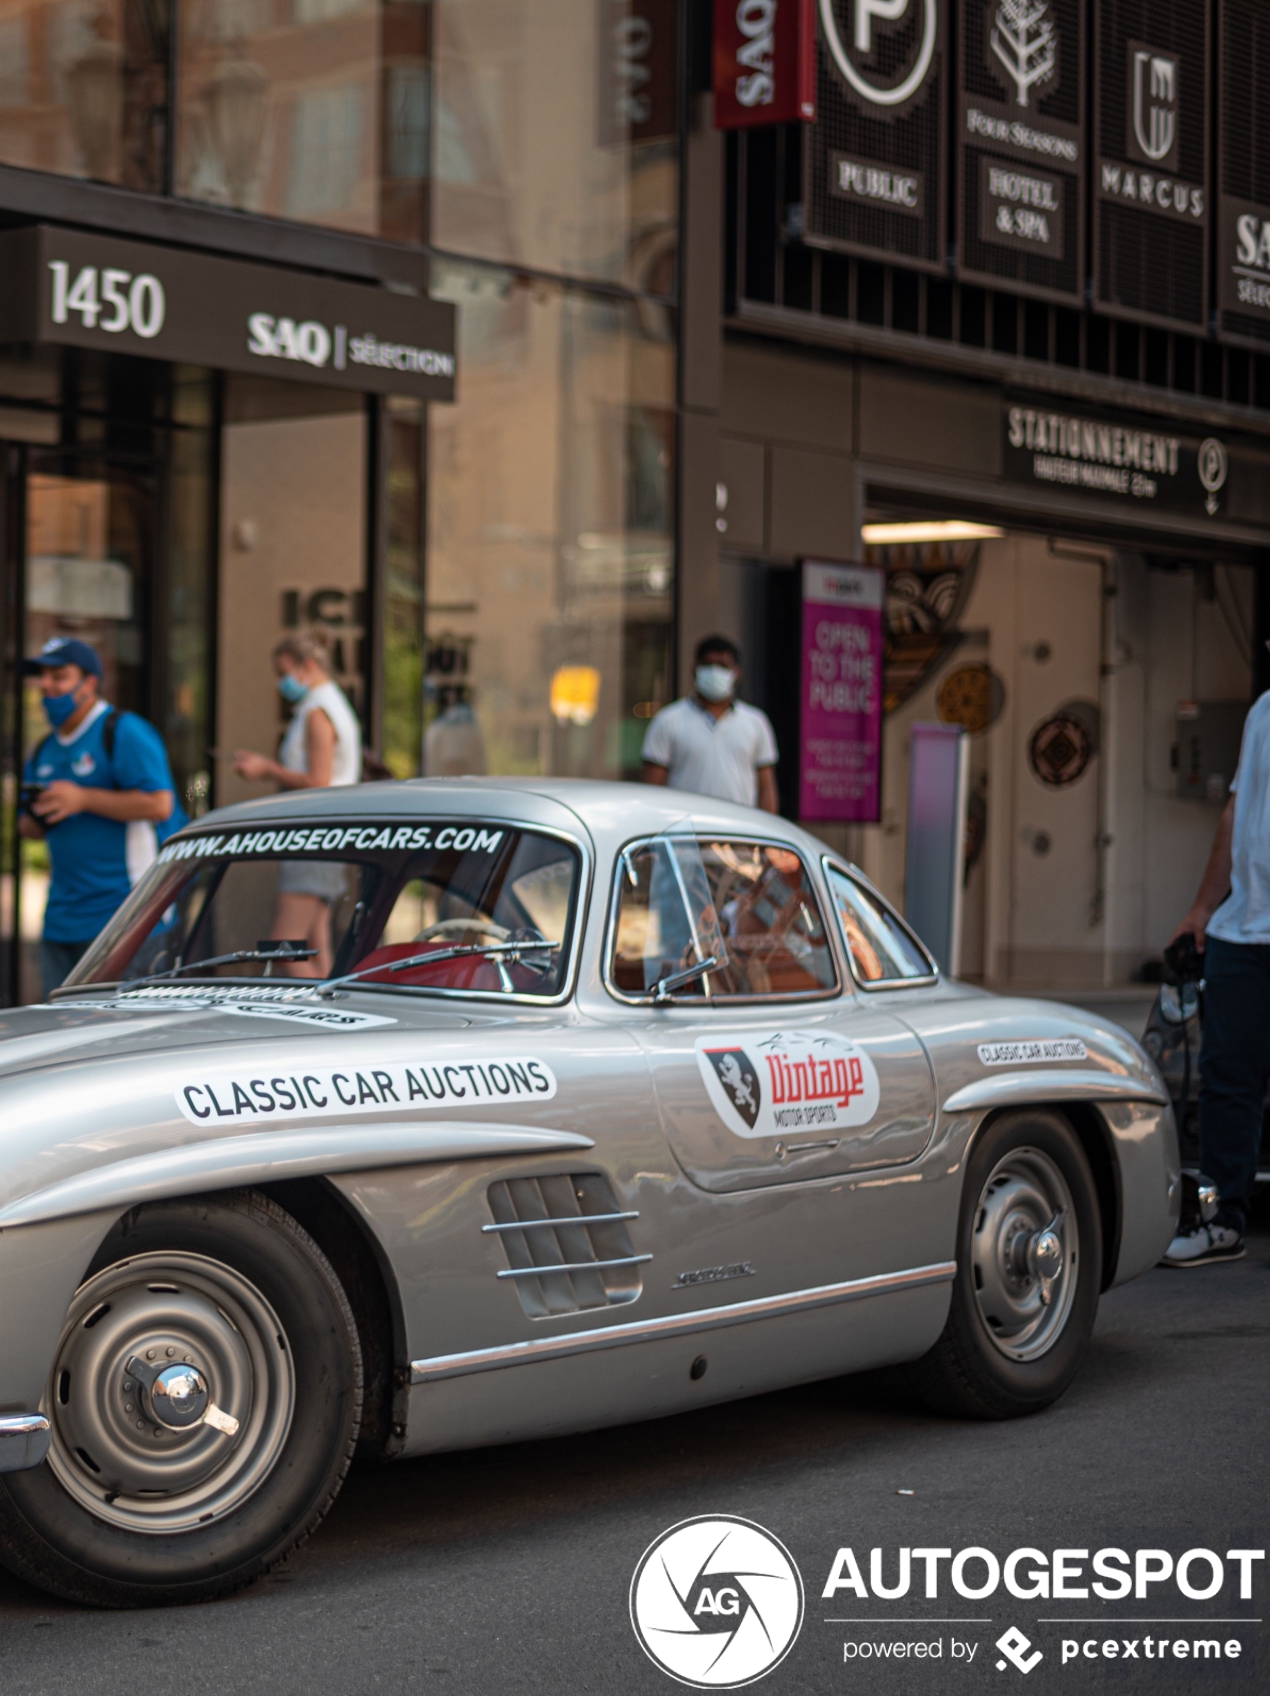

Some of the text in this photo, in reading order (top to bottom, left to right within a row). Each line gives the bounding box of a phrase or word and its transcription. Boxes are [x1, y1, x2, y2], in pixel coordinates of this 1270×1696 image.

[967, 108, 1078, 161] FOUR SEASONS
[839, 161, 918, 207] PUBLIC
[988, 168, 1058, 211] HOTEL
[1102, 164, 1204, 217] MARCUS
[996, 205, 1049, 243] & SPA
[48, 260, 166, 338] 1450
[248, 312, 330, 368] SAQ
[1009, 407, 1179, 476] STATIONNEMENT
[815, 620, 872, 651] OPEN
[808, 649, 875, 682] TO THE
[809, 679, 875, 715] PUBLIC
[157, 827, 504, 866] WWW.AHOUSEOFCARS.COM
[1023, 1043, 1041, 1060] CAR
[183, 1061, 550, 1119] CLASSIC CAR AUCTIONS
[765, 1053, 865, 1109] Vintage
[773, 1106, 805, 1129] MOTOR
